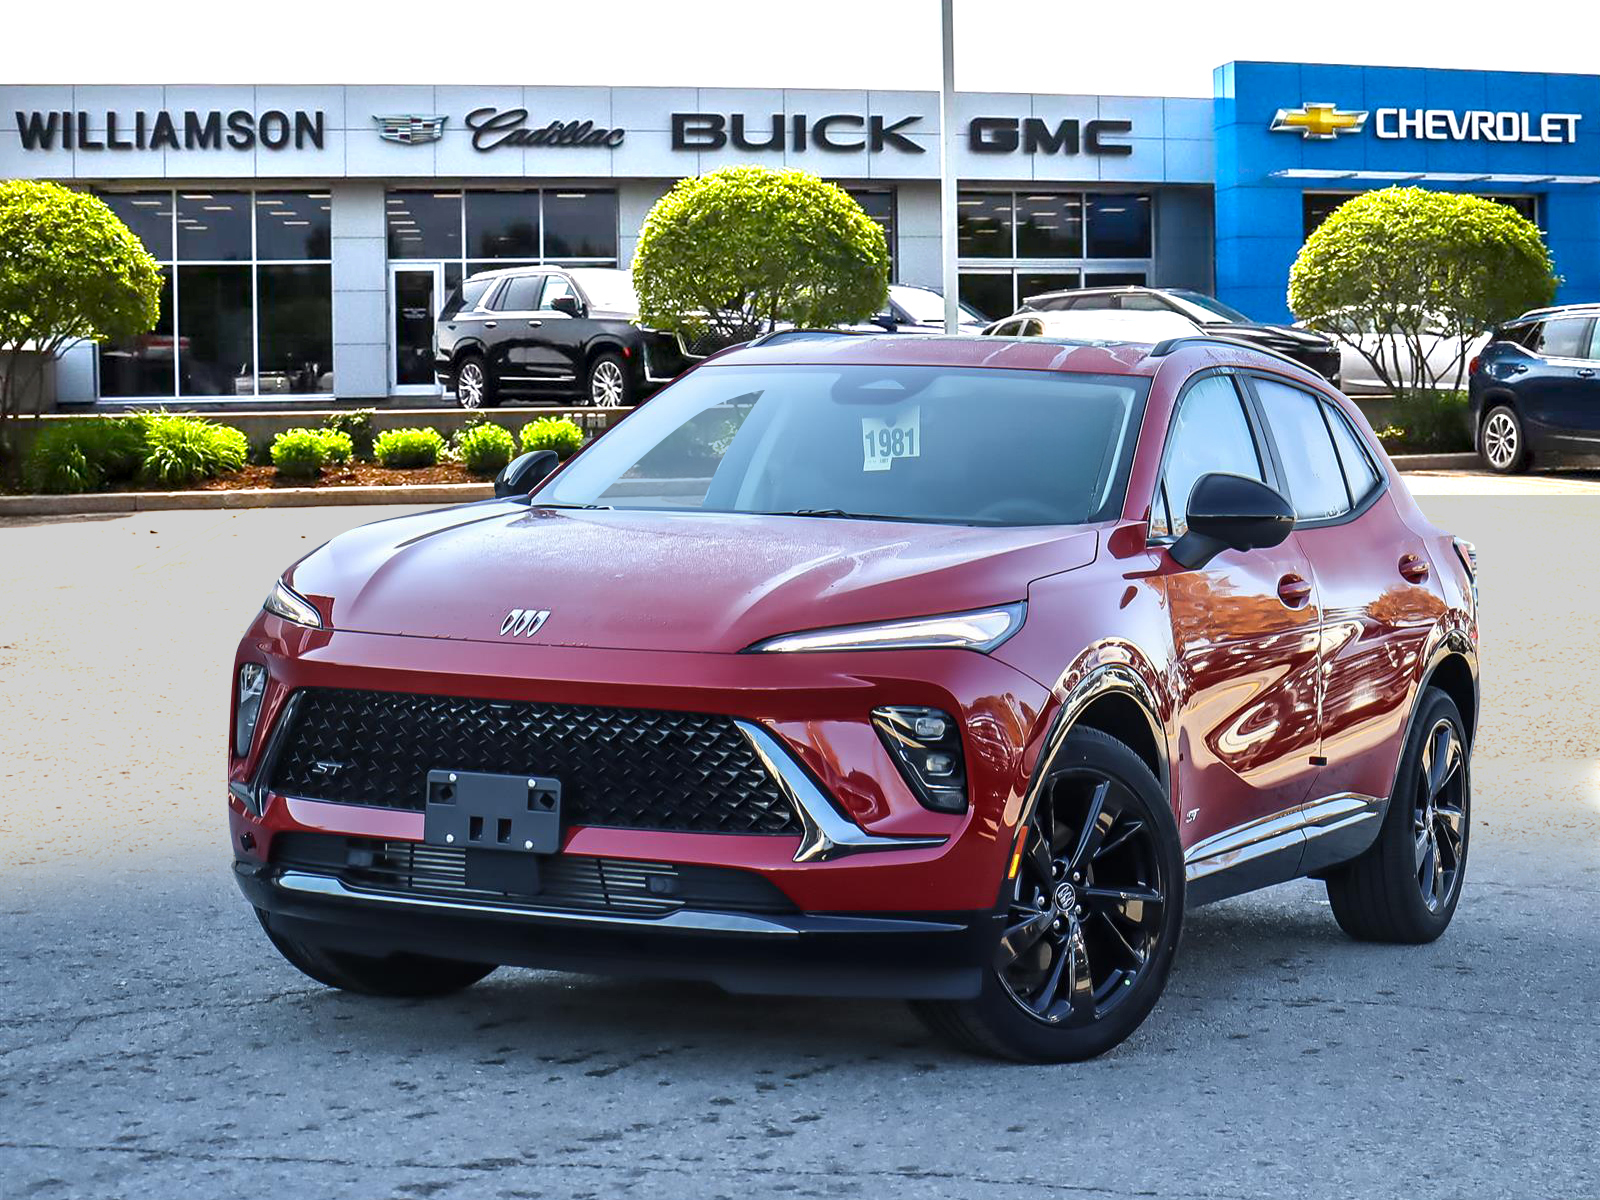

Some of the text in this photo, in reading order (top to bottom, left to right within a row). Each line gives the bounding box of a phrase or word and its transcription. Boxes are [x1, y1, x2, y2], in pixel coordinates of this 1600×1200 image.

[16, 111, 324, 151] WILLIAMSON
[465, 107, 625, 152] Cadillac
[671, 113, 925, 153] BUICK
[970, 117, 1133, 155] GMC
[1375, 108, 1582, 144] CHEVROLET
[865, 428, 914, 457] 1981
[312, 761, 342, 775] ST
